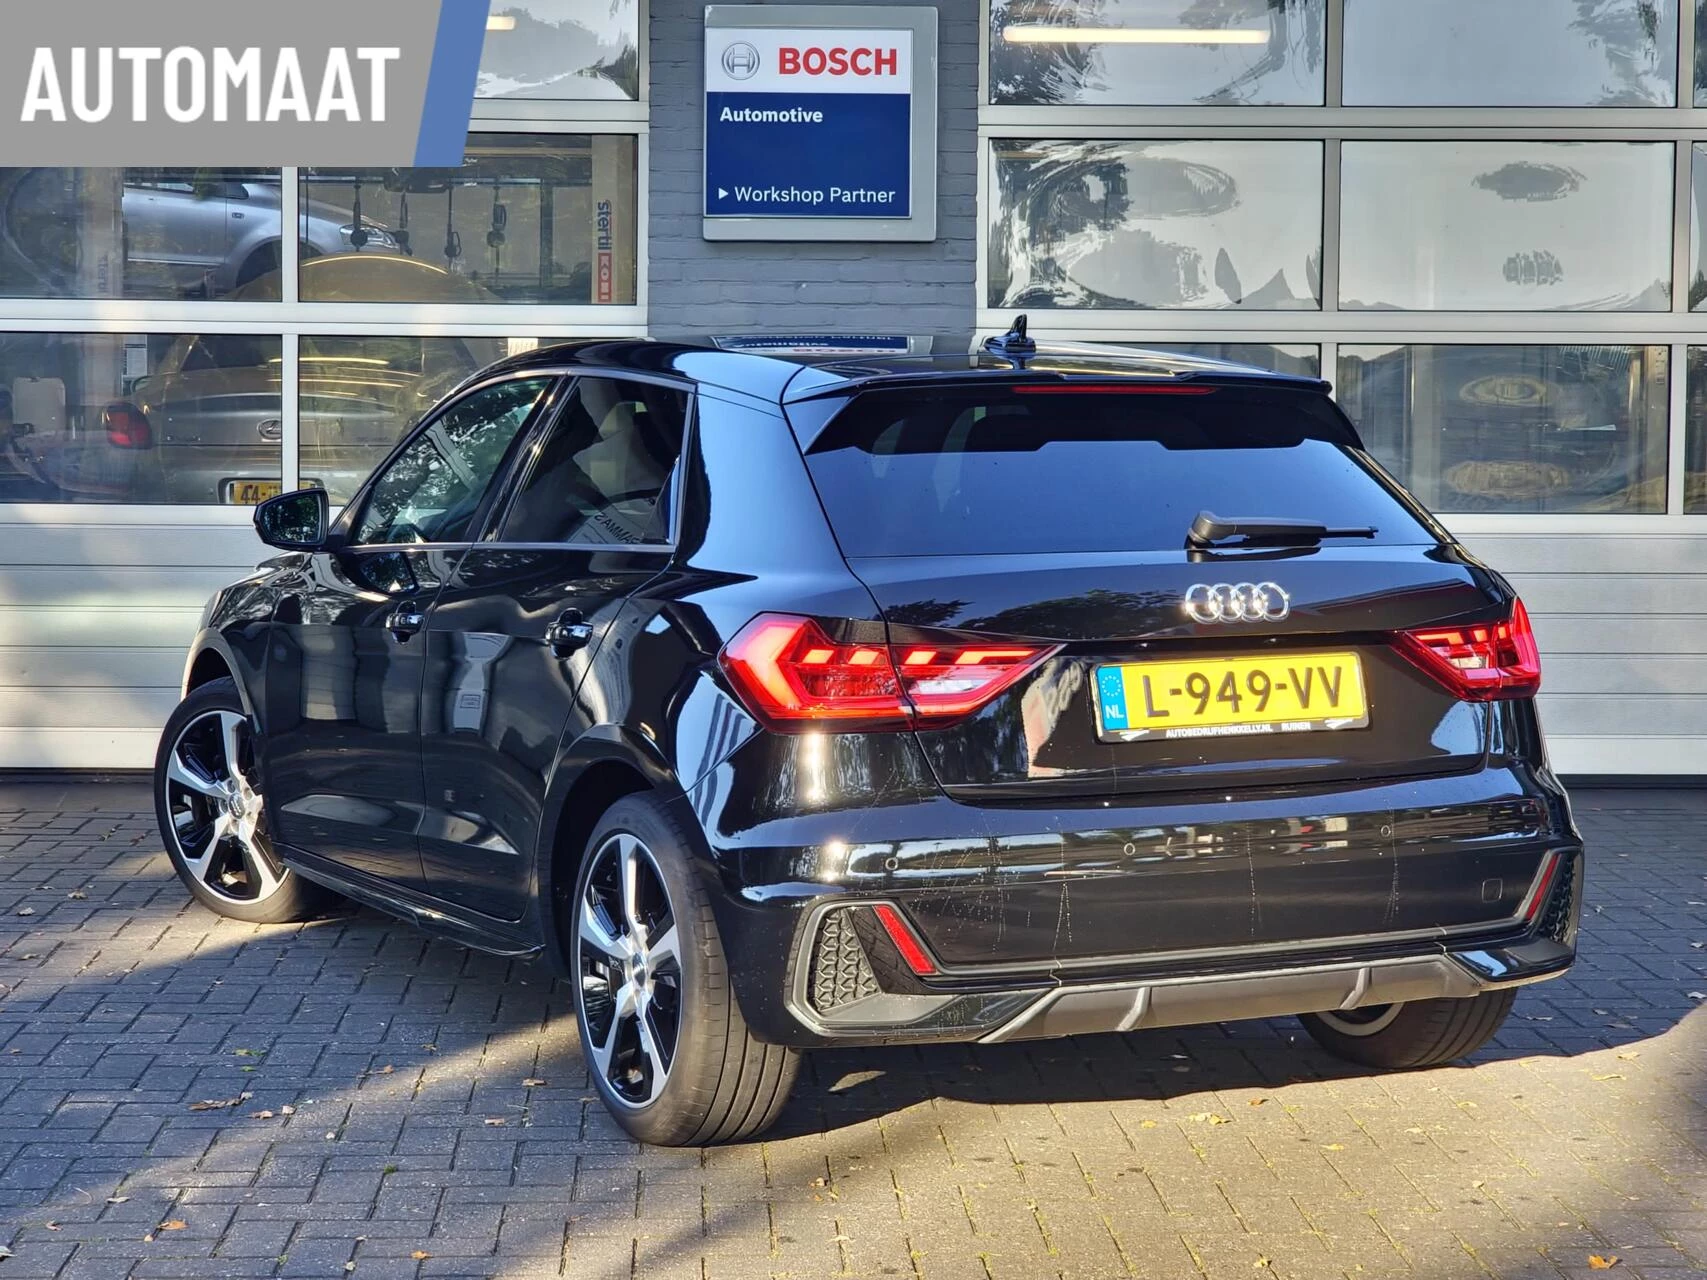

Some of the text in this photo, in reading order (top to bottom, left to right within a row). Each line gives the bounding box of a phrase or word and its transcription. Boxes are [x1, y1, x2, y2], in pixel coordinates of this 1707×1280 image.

[779, 47, 897, 76] BOSCH
[720, 107, 823, 123] Automotive
[735, 187, 895, 205] Workshop Partner
[598, 201, 611, 250] stertil
[1142, 666, 1342, 718] L-949-VV
[1105, 705, 1125, 719] NL
